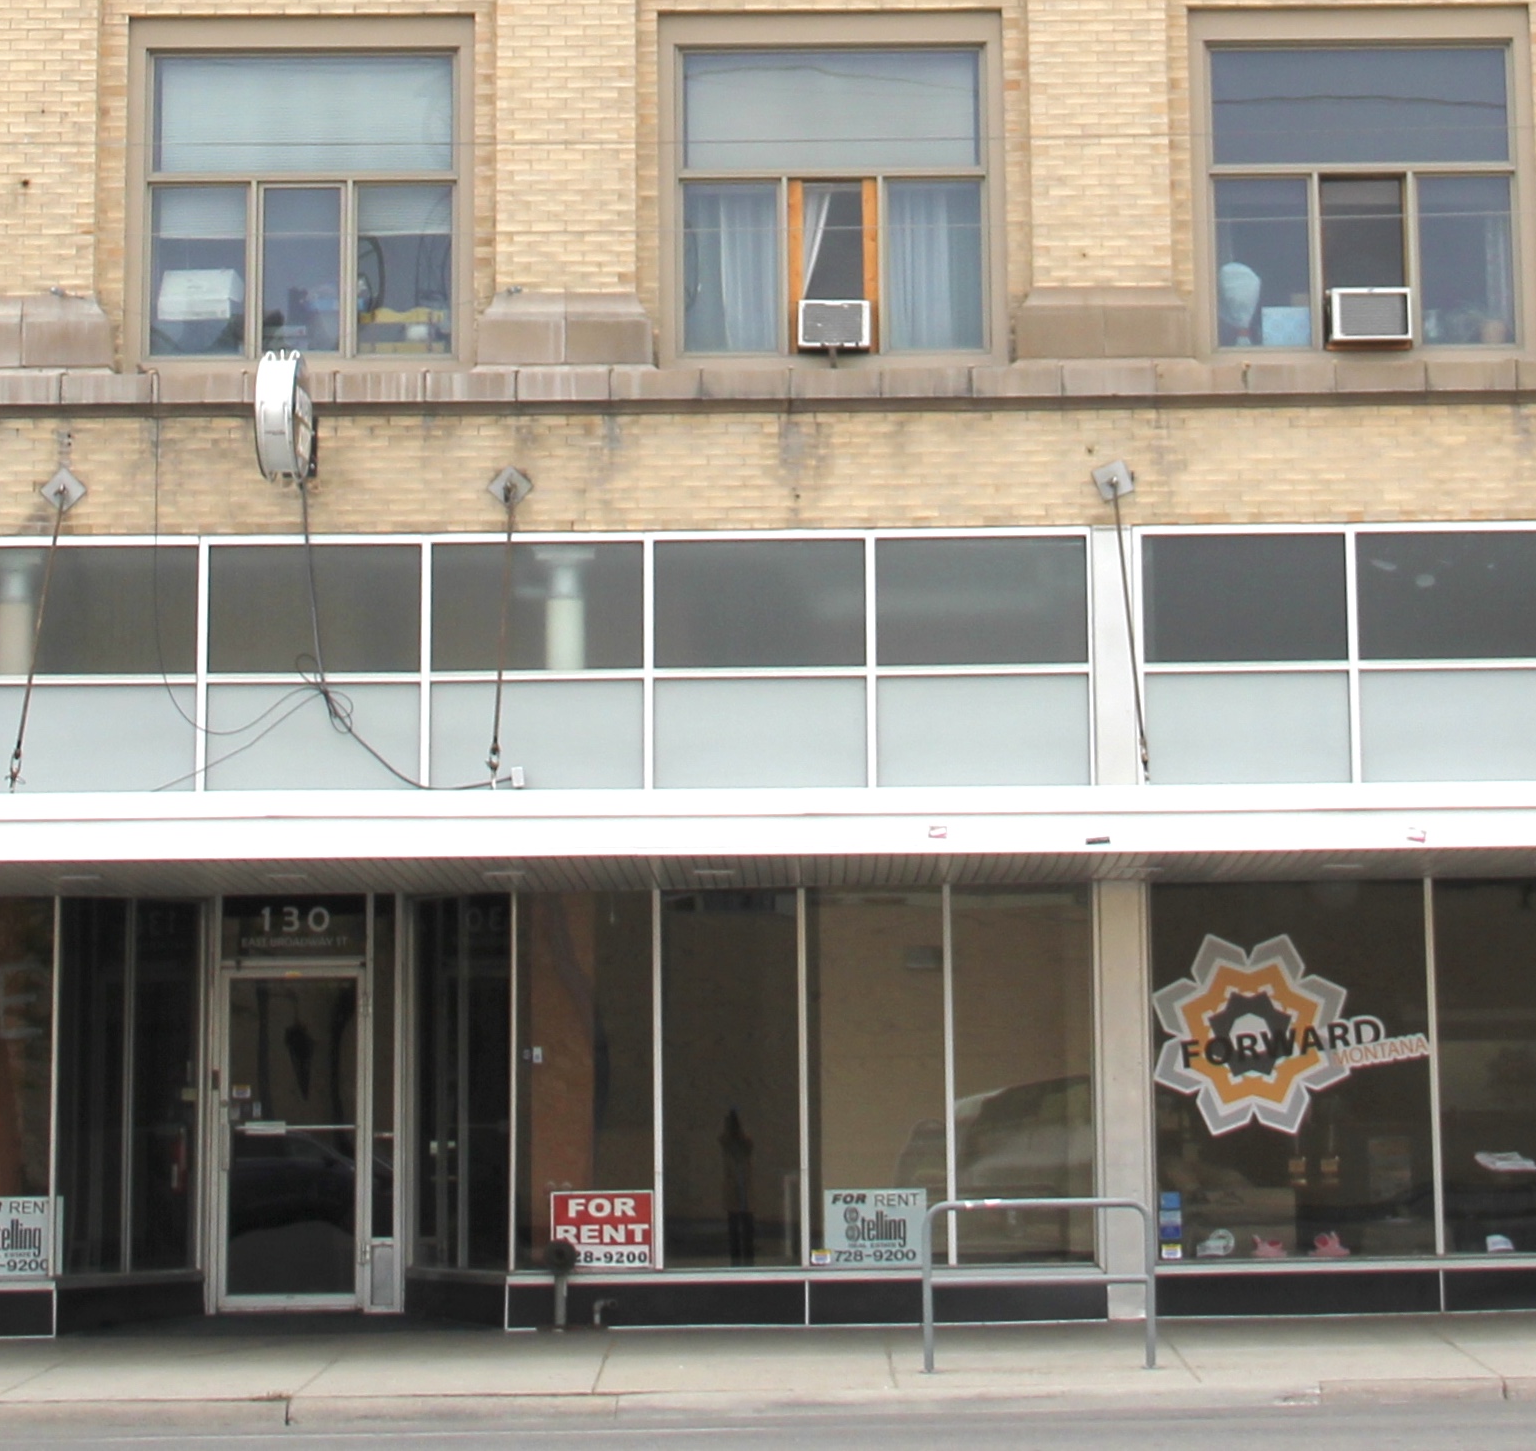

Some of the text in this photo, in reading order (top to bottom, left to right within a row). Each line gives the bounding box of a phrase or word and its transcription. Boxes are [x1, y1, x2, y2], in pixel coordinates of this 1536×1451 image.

[261, 906, 331, 932] 130
[270, 936, 334, 948] BROADWAY
[1181, 1019, 1381, 1068] FORWARD
[1333, 1036, 1428, 1066] MONTANA
[9, 1201, 49, 1214] REN
[568, 1197, 637, 1218] FOR
[831, 1193, 919, 1206] FOR RENT
[555, 1224, 650, 1243] RENT
[843, 1206, 906, 1248] Stelling
[834, 1249, 916, 1262] 728-9200
